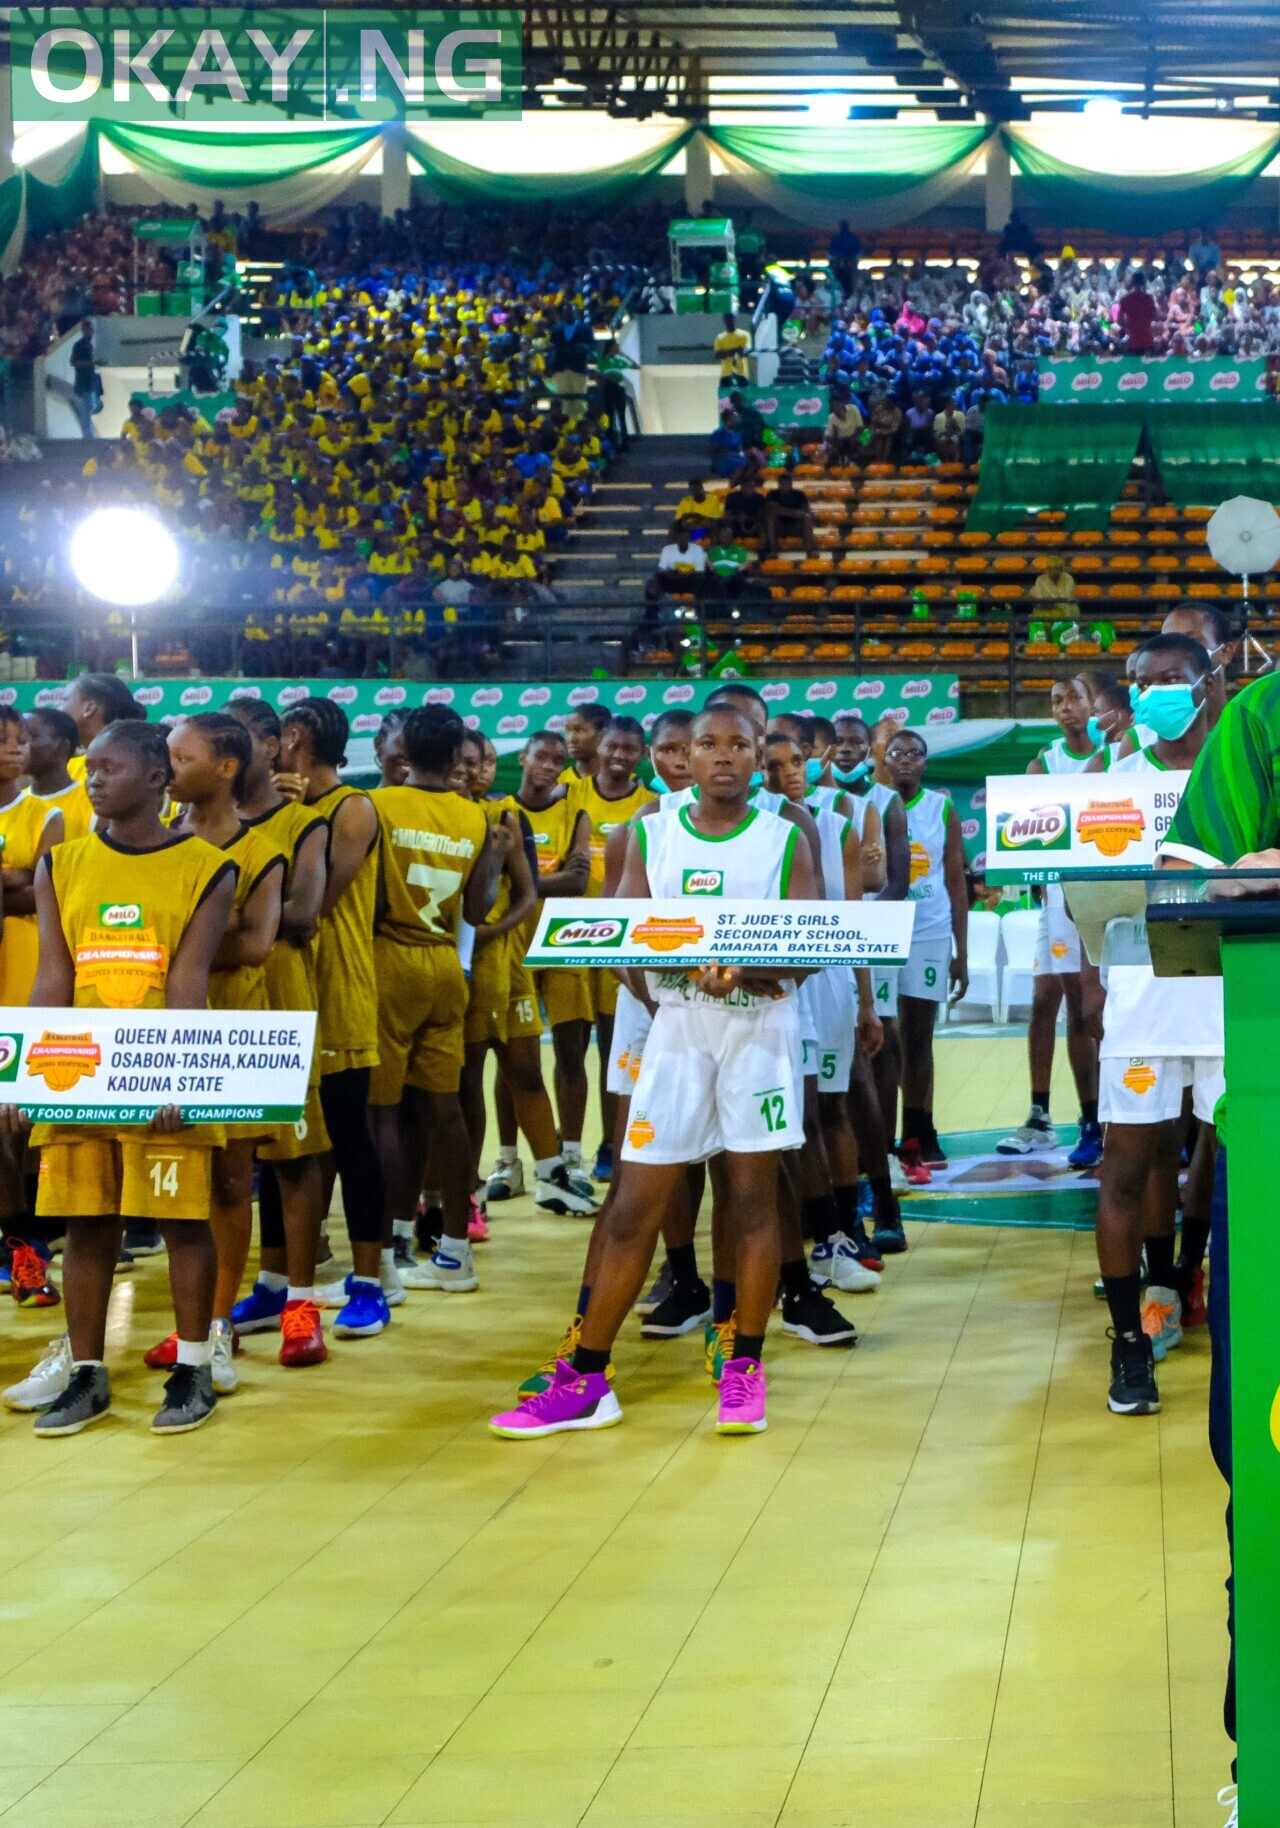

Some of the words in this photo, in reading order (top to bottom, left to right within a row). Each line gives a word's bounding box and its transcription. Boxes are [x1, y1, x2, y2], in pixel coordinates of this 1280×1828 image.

[1076, 376, 1099, 386] MILO
[1122, 376, 1145, 386] MILO
[1168, 376, 1191, 386] MILO
[1213, 375, 1237, 386] MILO
[763, 688, 788, 698] MILO
[809, 686, 834, 696] MILO
[857, 685, 882, 695] MILO
[905, 683, 930, 693] MILO
[136, 690, 161, 700] MILO
[184, 690, 209, 700] MILO
[281, 690, 307, 701] MILO
[330, 690, 355, 700] MILO
[379, 690, 404, 700] MILO
[427, 691, 452, 701] MILO
[474, 691, 500, 702] MILO
[522, 690, 548, 701] MILO
[571, 689, 597, 701] MILO
[618, 689, 643, 699] MILO
[667, 689, 693, 699] MILO
[929, 710, 954, 720] MILO
[355, 717, 380, 728] MILO
[501, 717, 526, 728] MILO
[1081, 813, 1140, 823] CHAMPIONSHIP
[1011, 817, 1060, 838] MILO
[1023, 872, 1045, 881] THE
[690, 877, 716, 888] MILO
[108, 910, 136, 921] MILO
[717, 914, 737, 926] ST.
[742, 914, 793, 926] JUDE'S
[797, 915, 840, 926] GIRLS
[560, 927, 615, 939] MILO
[714, 930, 802, 940] SECONDARY
[710, 943, 778, 952] AMARATA
[787, 943, 851, 953] BAYELSA
[857, 944, 899, 953] STATE
[924, 966, 937, 987] 9
[877, 981, 889, 1002] 4
[516, 1000, 533, 1023] 15
[114, 1028, 167, 1047] QUEEN
[171, 1029, 223, 1046] AMINA
[228, 1029, 302, 1048] COLLEGE,
[821, 1054, 836, 1079] 5
[107, 1076, 172, 1092] KADUNA
[177, 1076, 224, 1093] STATE
[37, 1108, 73, 1120] FOOD
[76, 1108, 116, 1120] DRINK
[119, 1108, 136, 1120] OF
[188, 1108, 263, 1119] CHAMPIONS
[760, 1095, 787, 1132] 12
[150, 1161, 178, 1197] 14
